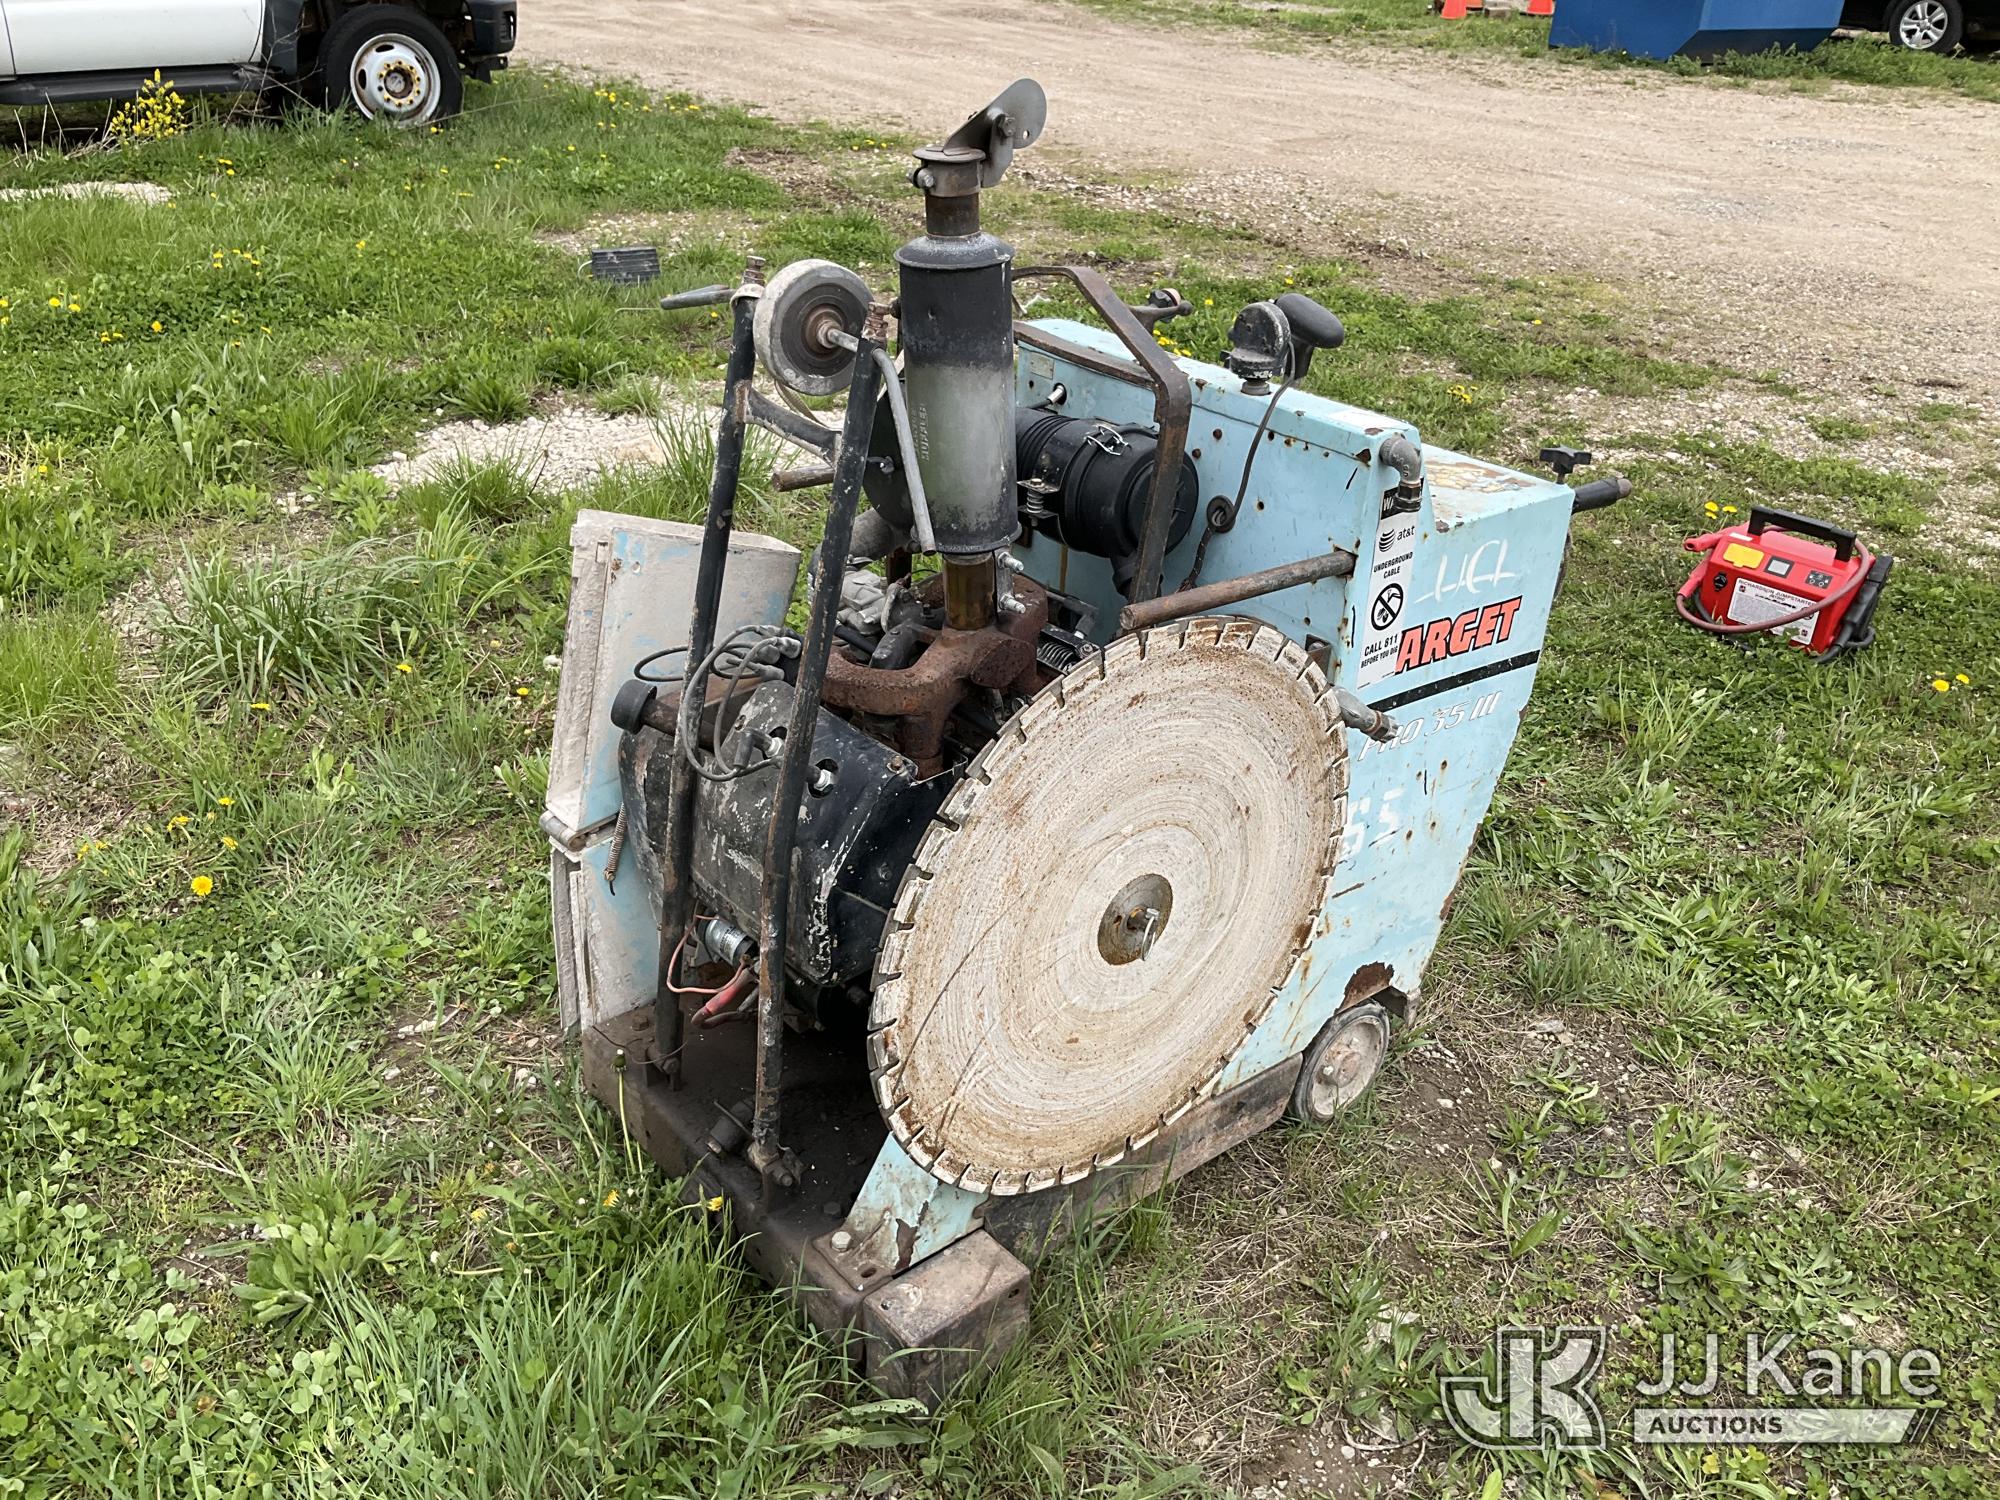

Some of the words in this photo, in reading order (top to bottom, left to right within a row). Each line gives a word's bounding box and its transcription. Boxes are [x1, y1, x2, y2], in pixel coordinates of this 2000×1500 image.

[1397, 525, 1415, 541] at&t
[1373, 551, 1413, 573] UNDERGROUND
[1383, 565, 1401, 579] CABLE
[1364, 640, 1382, 657] CALL
[1384, 633, 1398, 648] 811
[1361, 653, 1379, 669] BEFORE
[1380, 649, 1390, 661] YOU
[1389, 645, 1398, 656] DIG
